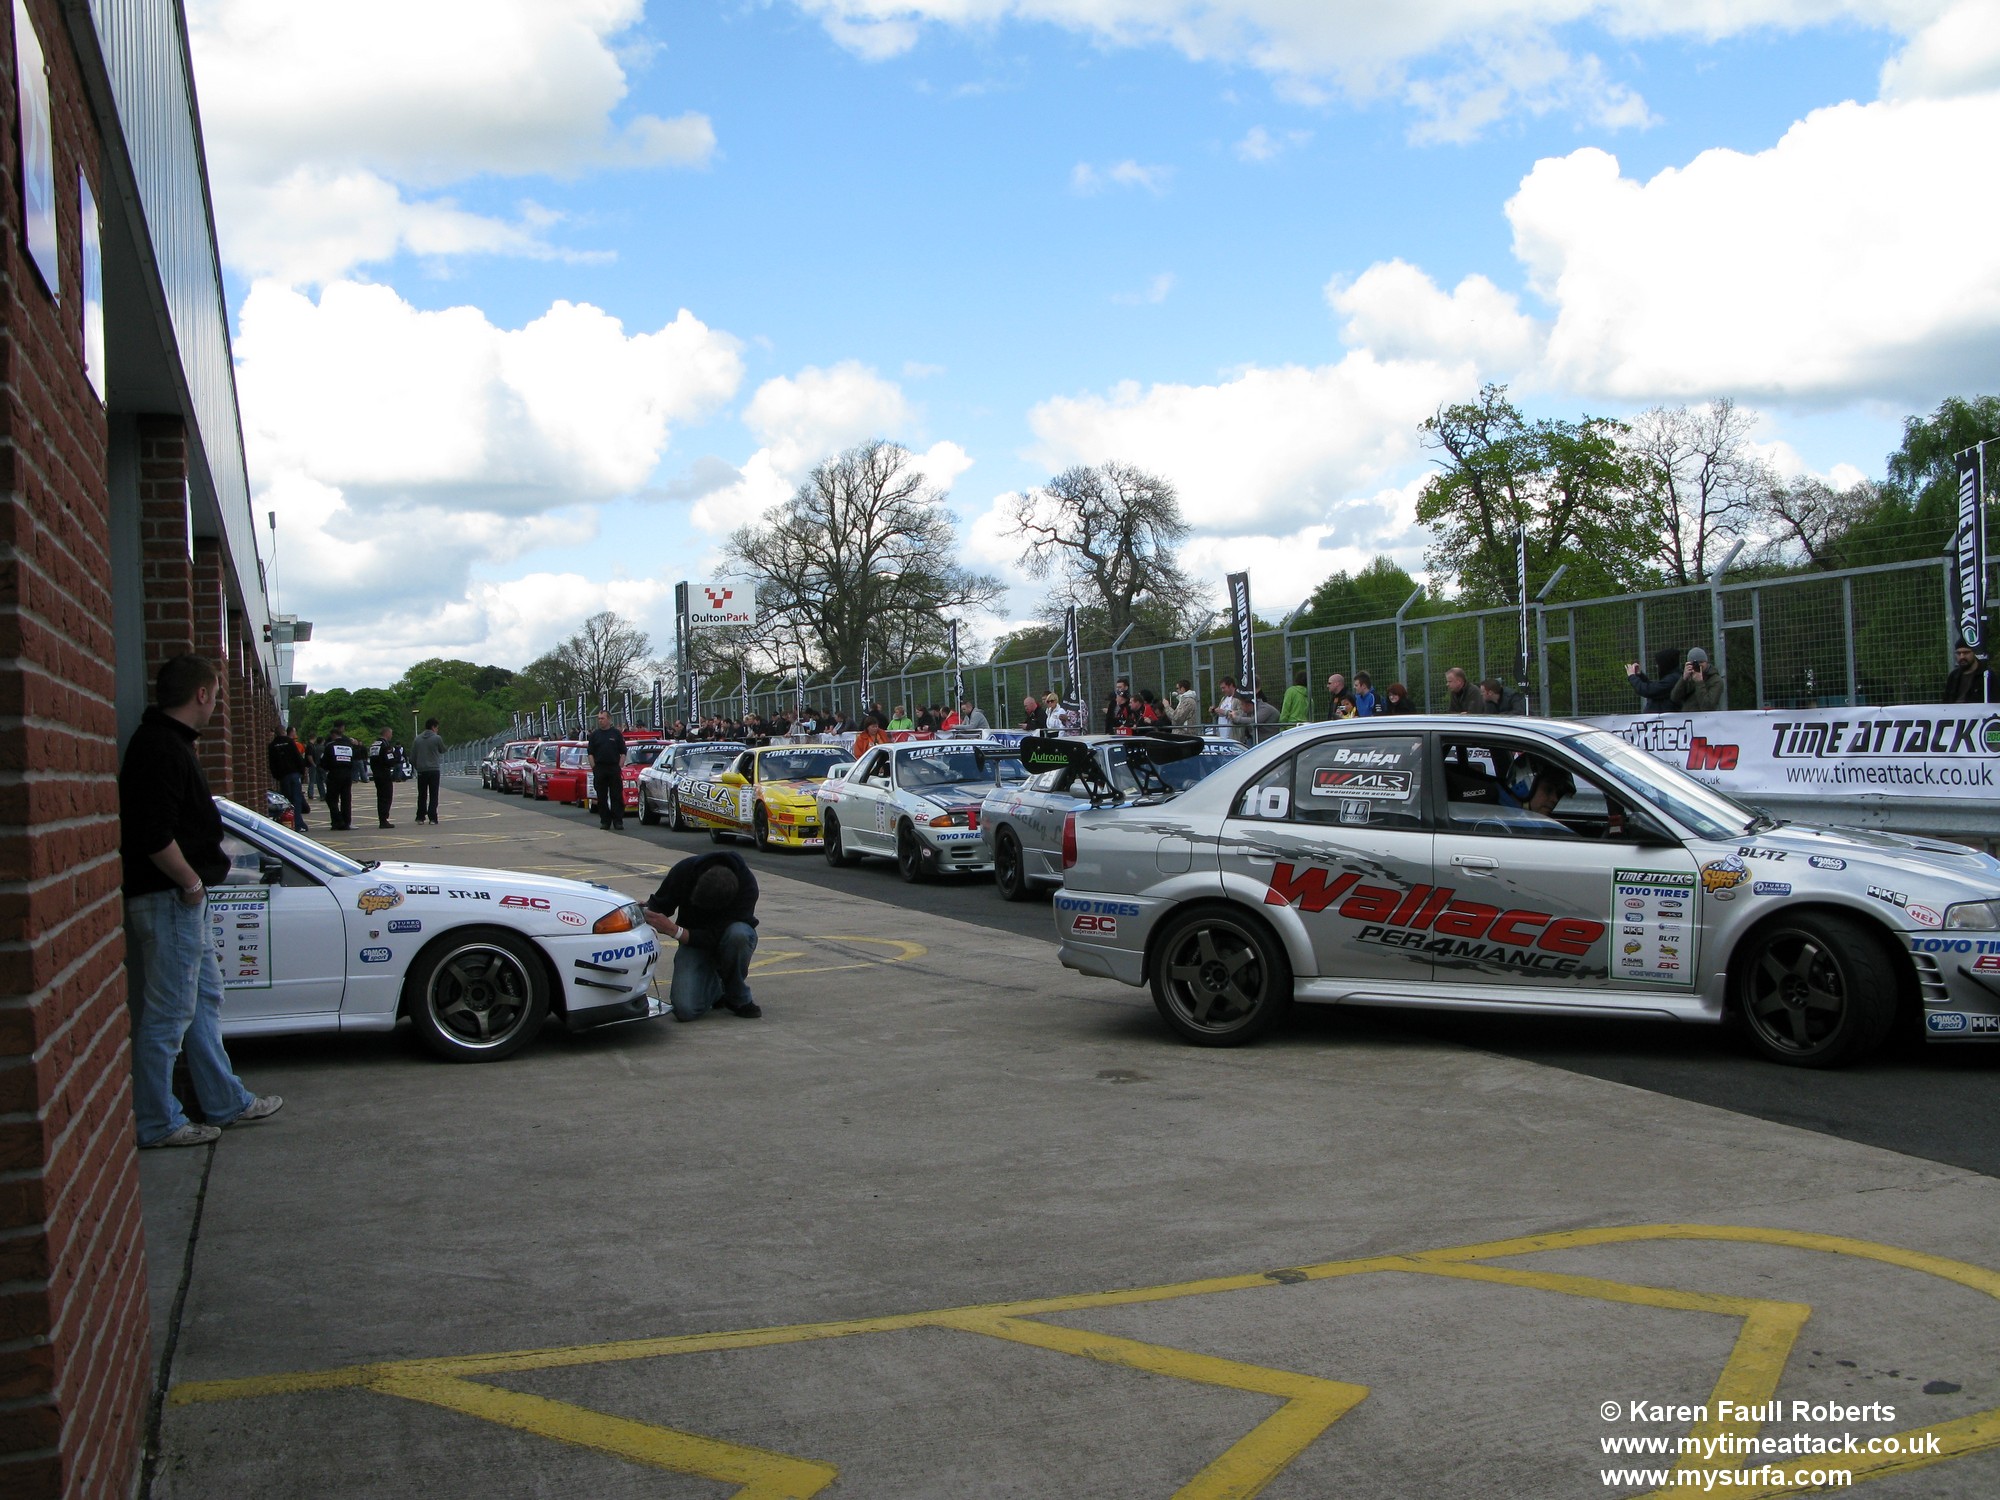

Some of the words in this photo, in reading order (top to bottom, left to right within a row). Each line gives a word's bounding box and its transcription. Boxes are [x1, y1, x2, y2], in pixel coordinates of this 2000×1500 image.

[1772, 721, 1849, 758] TIME
[1846, 719, 1979, 753] ATTACK
[1029, 751, 1069, 764] Autronic
[1786, 761, 1994, 786] www.timeattack.co.uk
[1243, 785, 1290, 818] 10
[1812, 855, 1842, 865] SAMCO
[1616, 871, 1644, 882] TIME
[1643, 872, 1684, 884] ATTACK
[406, 885, 440, 894] HKS
[1619, 886, 1651, 896] TOYO
[1653, 888, 1690, 899] TIRES
[1867, 885, 1908, 908] HKS
[231, 902, 265, 911] TIRES
[499, 895, 551, 910] BC
[1055, 898, 1091, 912] TOYO
[1094, 901, 1140, 916] TIRES
[1264, 862, 1605, 956] Wallace
[1072, 915, 1116, 932] BC
[1911, 910, 1936, 925] HEL
[1356, 925, 1581, 973] PER4MANCE
[1911, 938, 1972, 953] TOYO
[592, 946, 635, 963] TOYO
[1931, 1015, 1961, 1023] SAMCO
[1940, 1020, 1961, 1029] sport
[1971, 1016, 2000, 1032] HK
